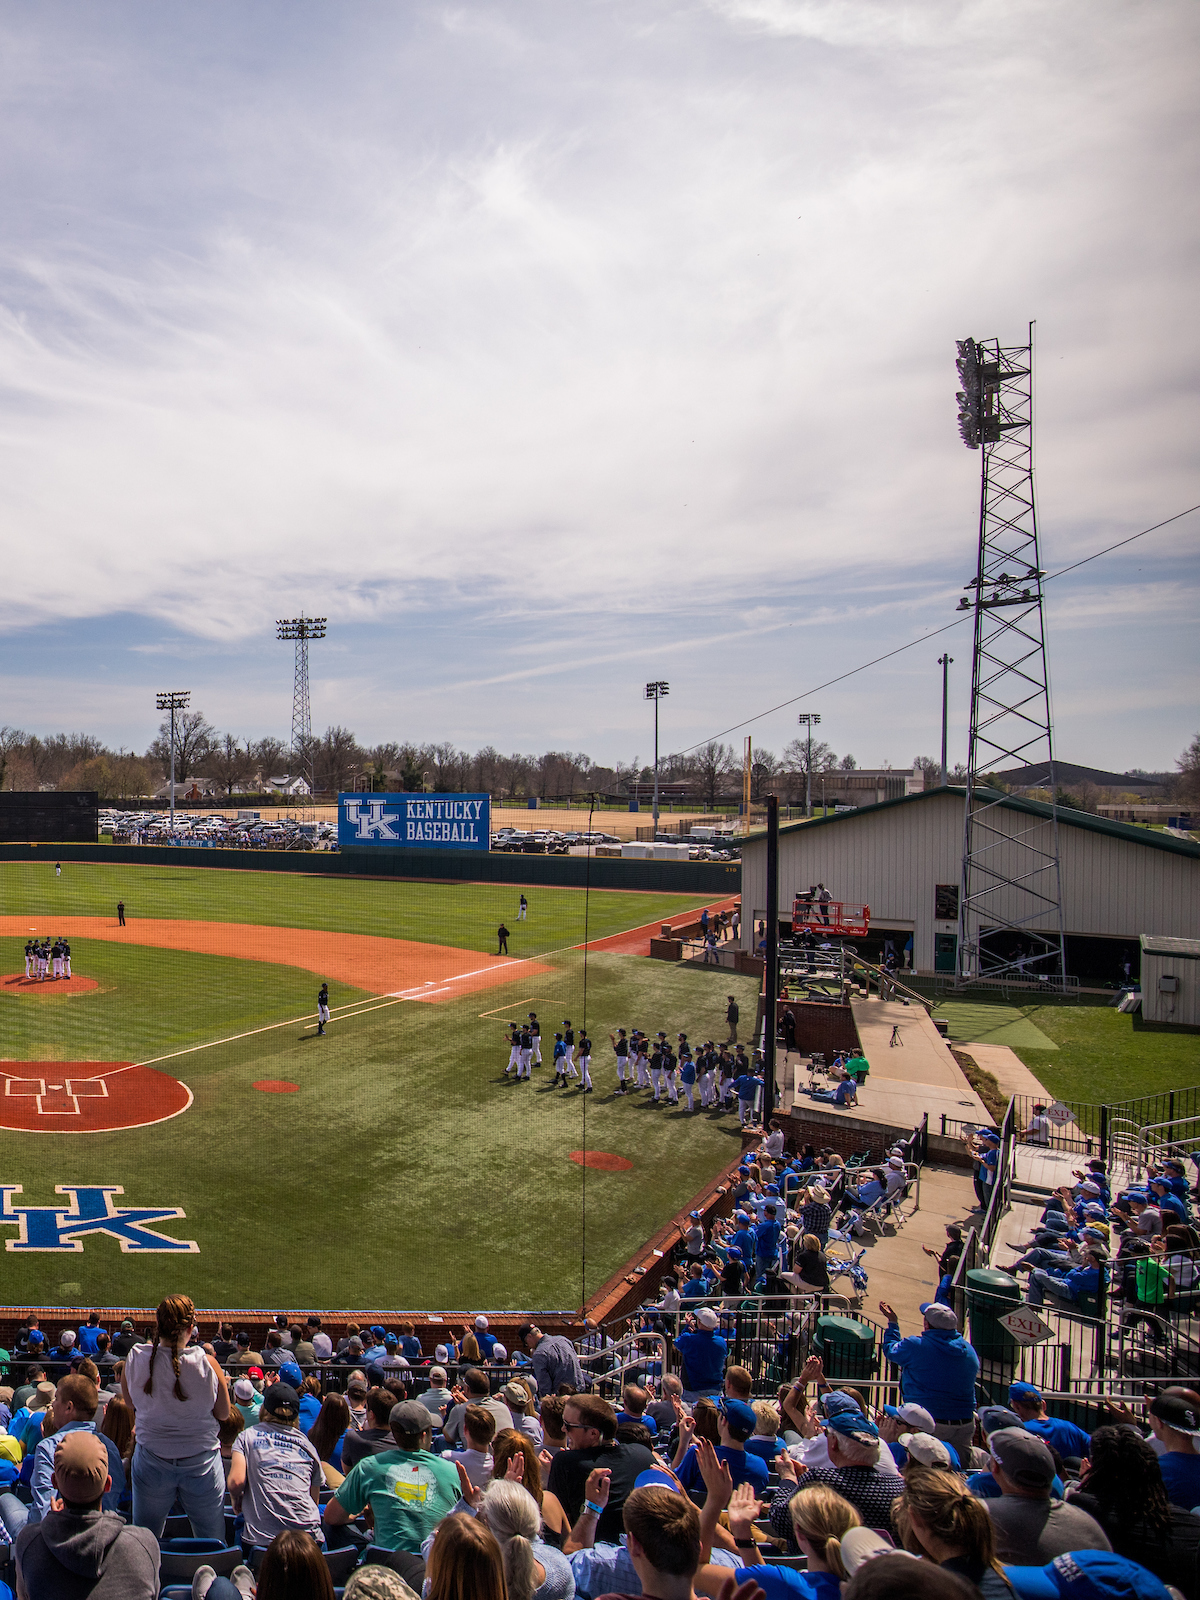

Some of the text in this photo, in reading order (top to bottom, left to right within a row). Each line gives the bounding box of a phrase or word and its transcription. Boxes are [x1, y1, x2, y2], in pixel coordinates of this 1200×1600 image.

[343, 799, 400, 840] UK
[406, 799, 484, 820] KENTUCKY
[406, 821, 479, 843] BASEBALL
[1047, 1108, 1071, 1118] EXIT
[1007, 1315, 1045, 1334] EXIT
